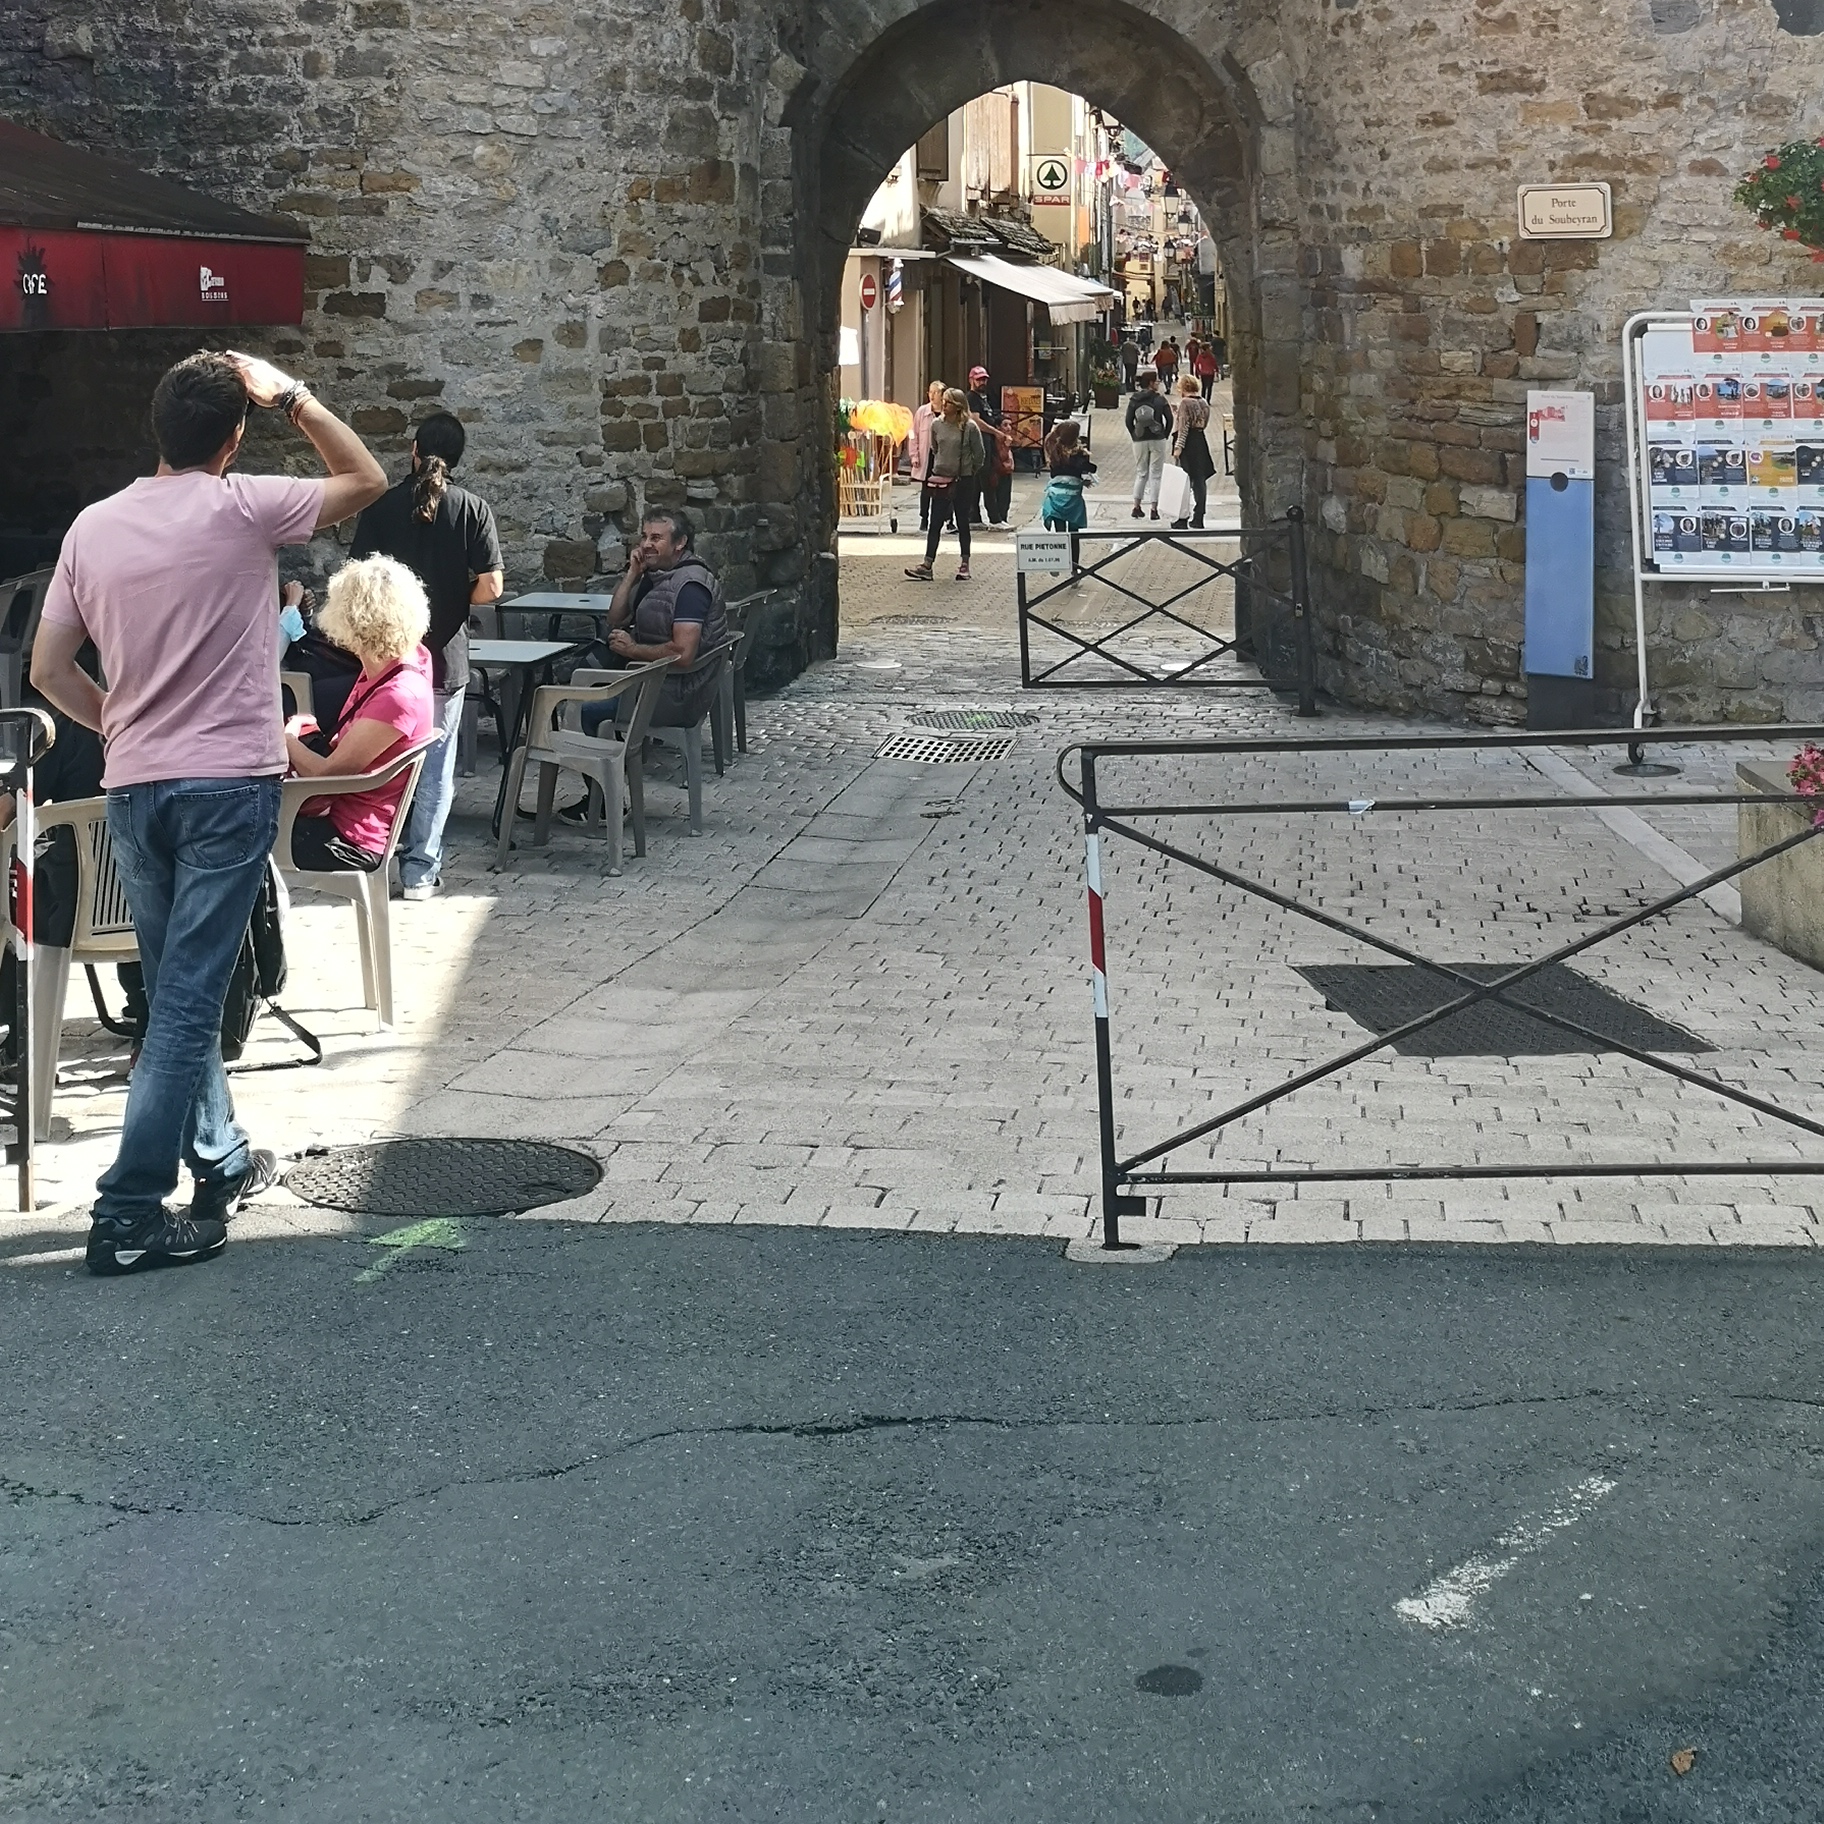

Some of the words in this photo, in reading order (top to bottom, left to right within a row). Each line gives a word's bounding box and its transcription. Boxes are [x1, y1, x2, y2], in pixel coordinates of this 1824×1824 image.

[1551, 198, 1577, 208] Porte
[1531, 215, 1543, 225] du
[1549, 213, 1598, 227] Soubeyran
[1020, 543, 1033, 551] RUE
